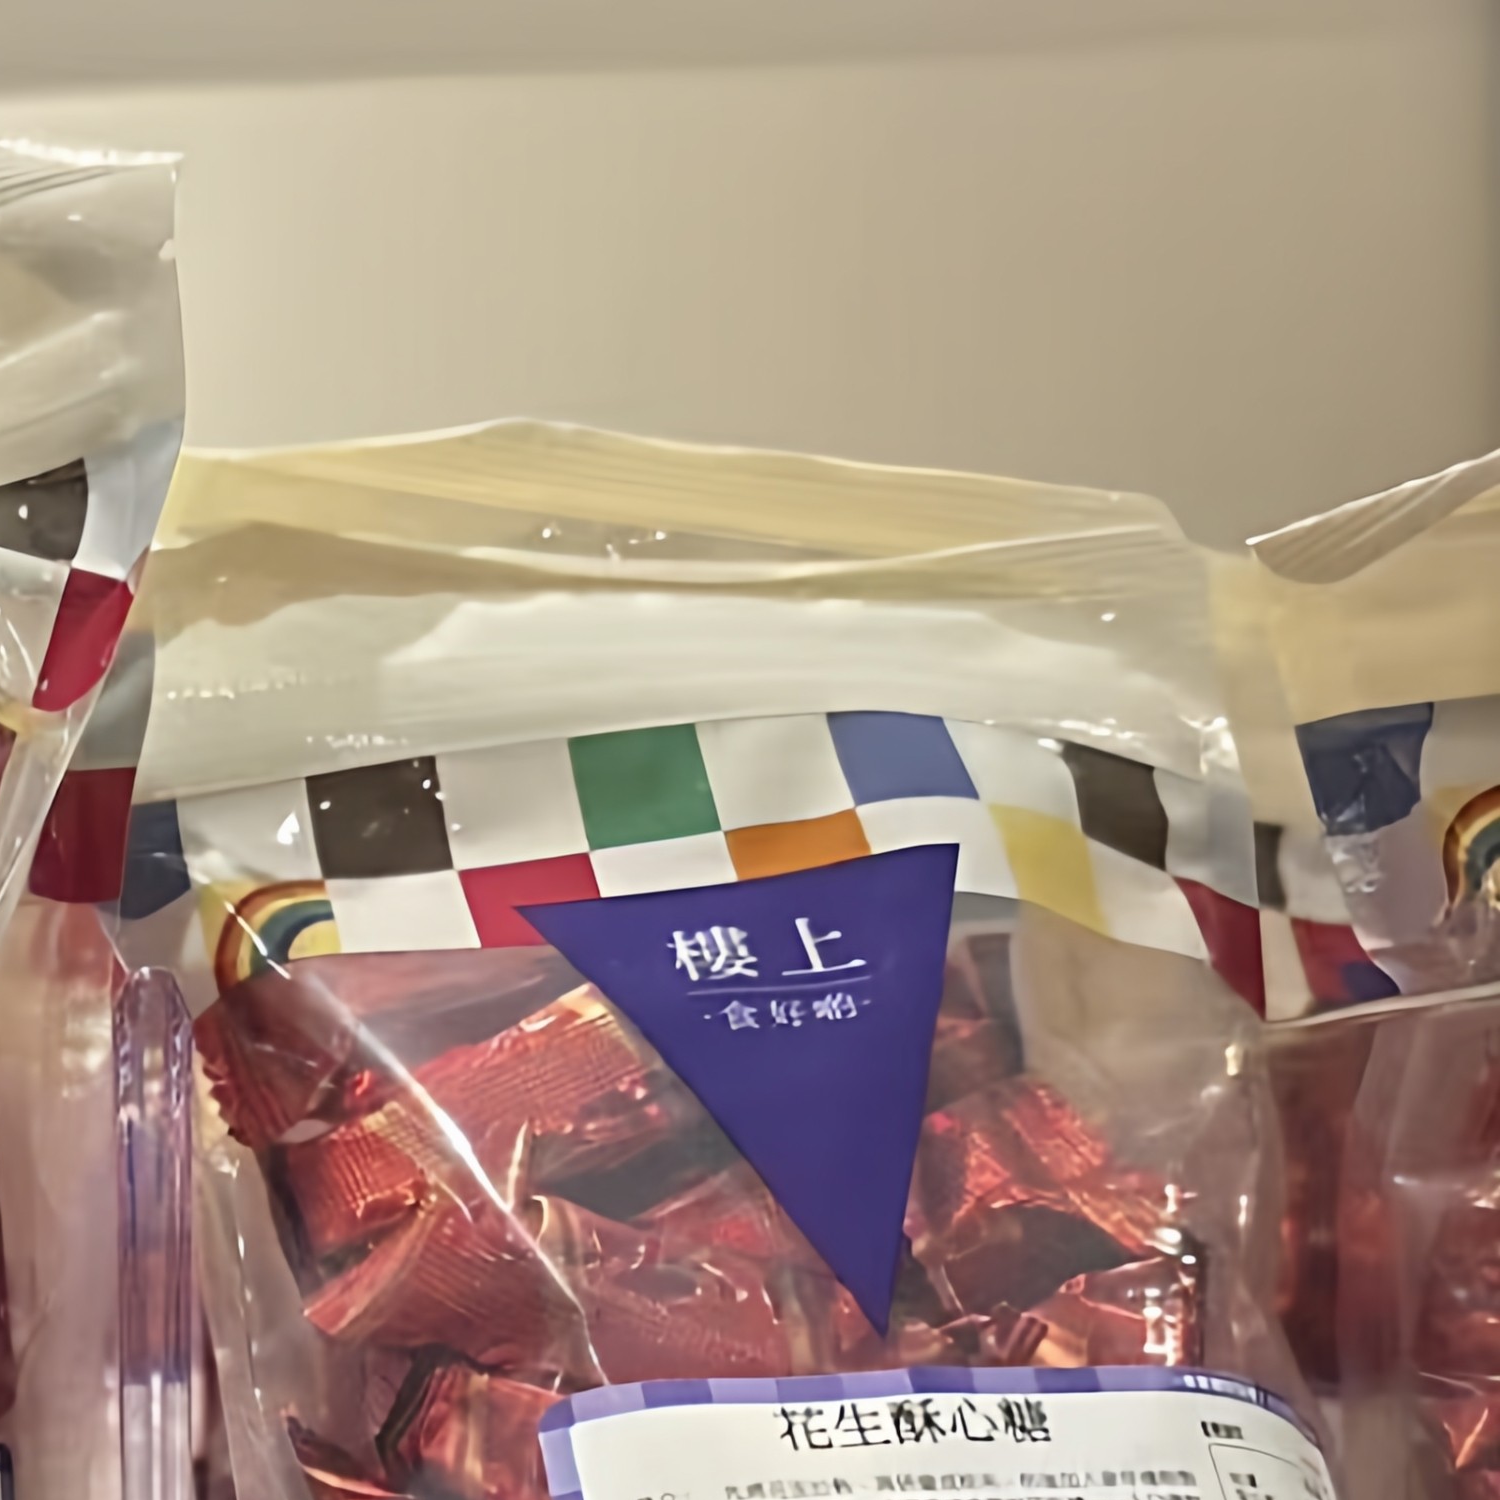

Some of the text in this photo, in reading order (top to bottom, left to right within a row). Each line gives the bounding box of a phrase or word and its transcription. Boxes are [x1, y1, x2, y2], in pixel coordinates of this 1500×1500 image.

[666, 916, 868, 982] 樓上
[773, 1397, 1053, 1451] 花生酥心糖
